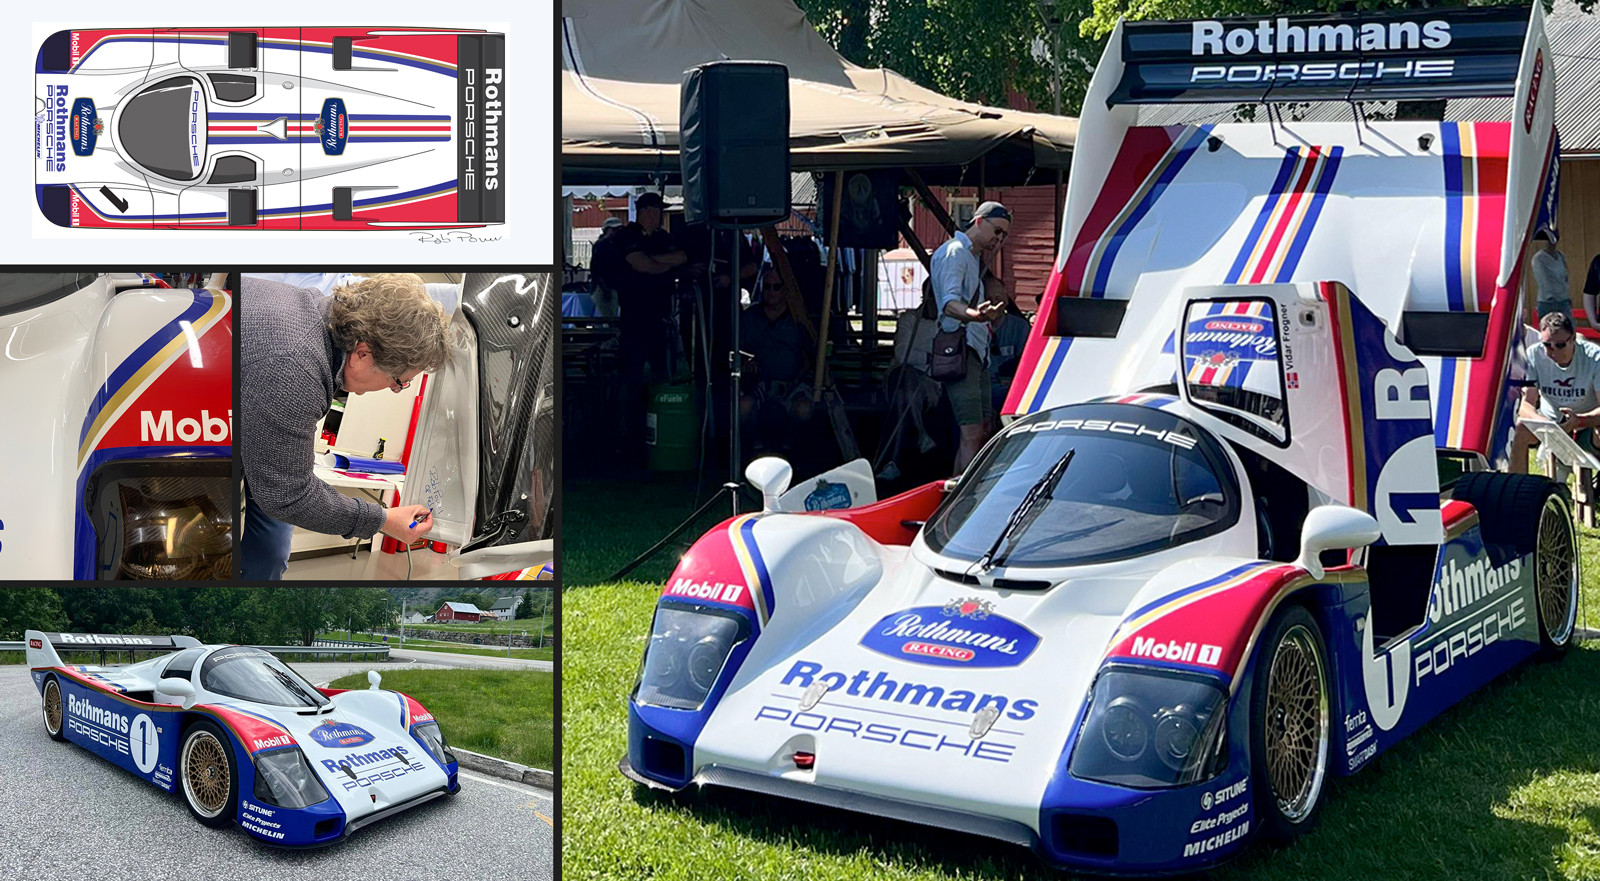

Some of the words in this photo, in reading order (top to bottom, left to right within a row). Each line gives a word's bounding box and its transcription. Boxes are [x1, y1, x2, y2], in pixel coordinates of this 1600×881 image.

[71, 32, 80, 56] Mobil
[1191, 18, 1452, 56] Rothmans
[1190, 60, 1455, 83] PORSCHE
[46, 84, 54, 172] PORSCHE
[56, 84, 69, 172] Rothmans
[80, 103, 93, 153] Rothmans
[190, 90, 200, 167] PORSCHE
[325, 101, 338, 151] Rothmans
[465, 68, 475, 191] PORSCHE
[485, 68, 502, 191] Rothmans
[71, 194, 80, 218] Mobil
[99, 185, 129, 214] 1
[1208, 322, 1258, 332] RACING
[1280, 303, 1291, 342] Frogner
[1185, 332, 1278, 356] Rothman
[1284, 344, 1294, 371] Vidar
[1005, 419, 1198, 451] PORSCHE
[670, 578, 725, 600] Mobil
[60, 632, 153, 646] Rothmans
[881, 613, 1019, 656] Rothmans
[1130, 636, 1198, 662] Mobil
[1414, 597, 1527, 687] PORSCHE
[908, 642, 969, 659] RACING
[779, 659, 1040, 722] Rothmans
[68, 693, 129, 734] Rothmans
[68, 718, 129, 755] PORSCHE
[139, 720, 147, 766] 1
[254, 737, 282, 750] Mobil
[317, 728, 367, 742] Rothmans
[754, 705, 1017, 763] PORSCHE
[320, 745, 409, 773] Rothmans
[342, 761, 426, 792] PORSCHE
[1214, 779, 1248, 805] SITUNE
[248, 803, 273, 818] SITUNE
[241, 820, 286, 840] MICHELIN
[1183, 820, 1250, 858] MICHELIN
